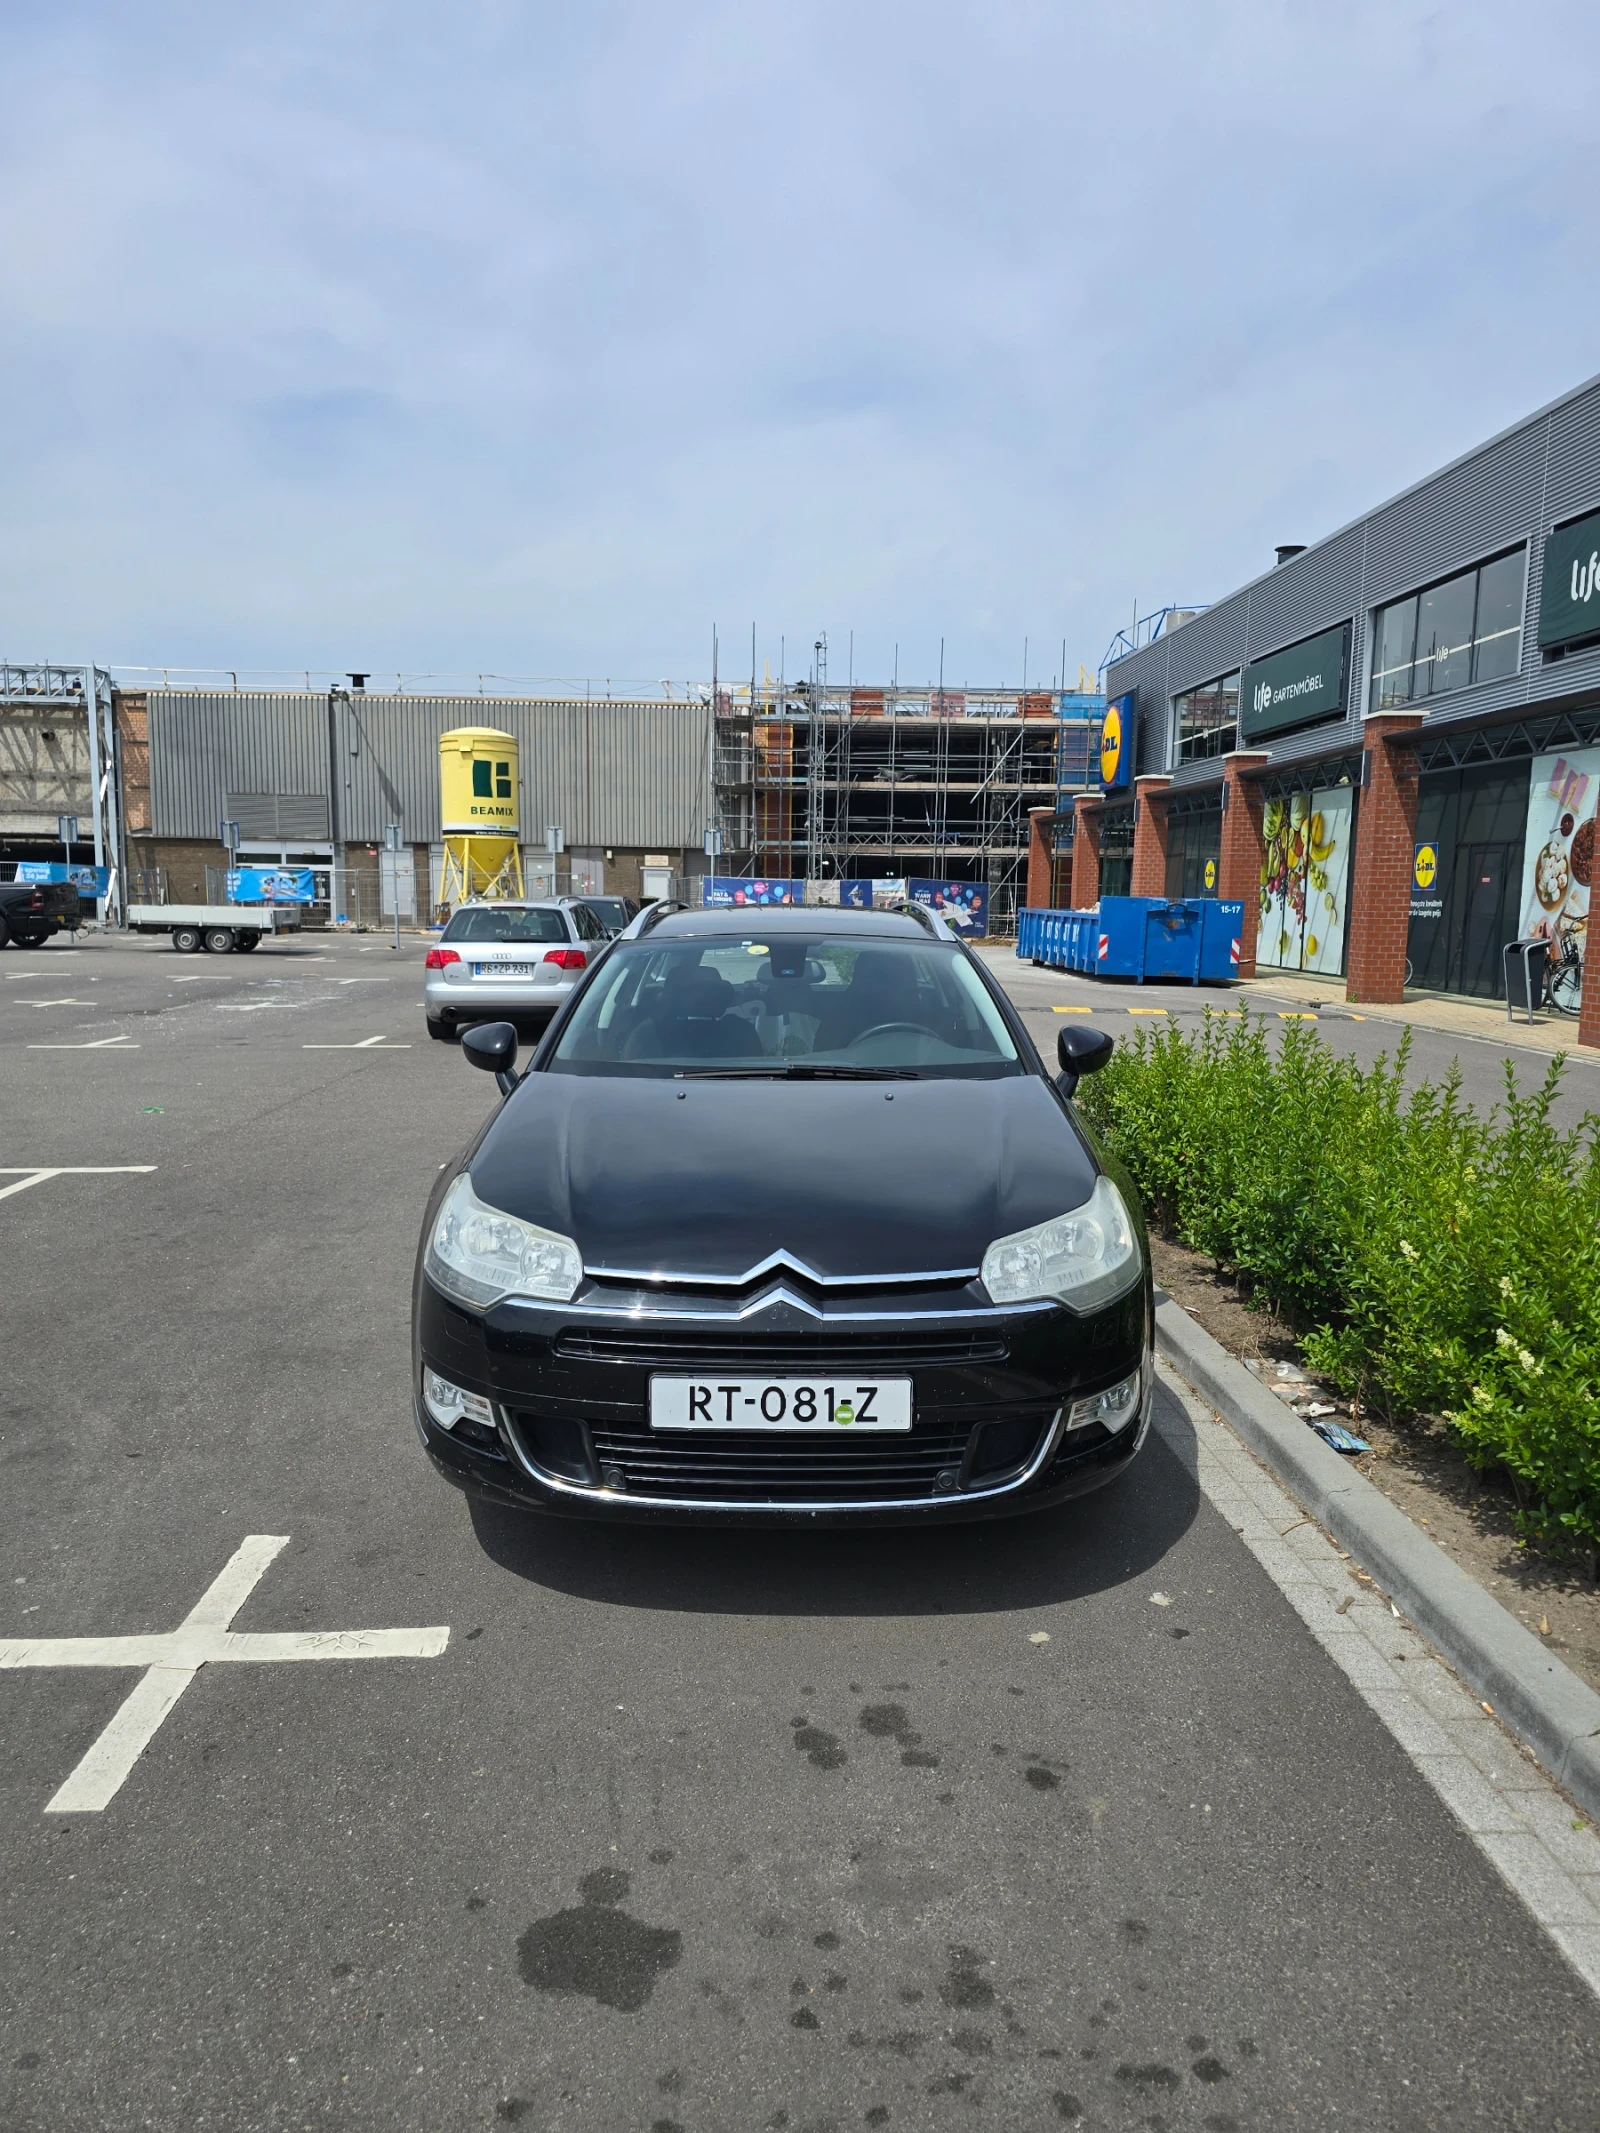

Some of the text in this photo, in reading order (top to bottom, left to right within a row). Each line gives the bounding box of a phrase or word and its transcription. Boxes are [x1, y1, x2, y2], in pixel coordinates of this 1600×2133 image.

[1254, 674, 1324, 713] life GARTENMÖBEL
[470, 806, 514, 817] BEAMIX
[689, 1385, 878, 1422] RT-081-Z
